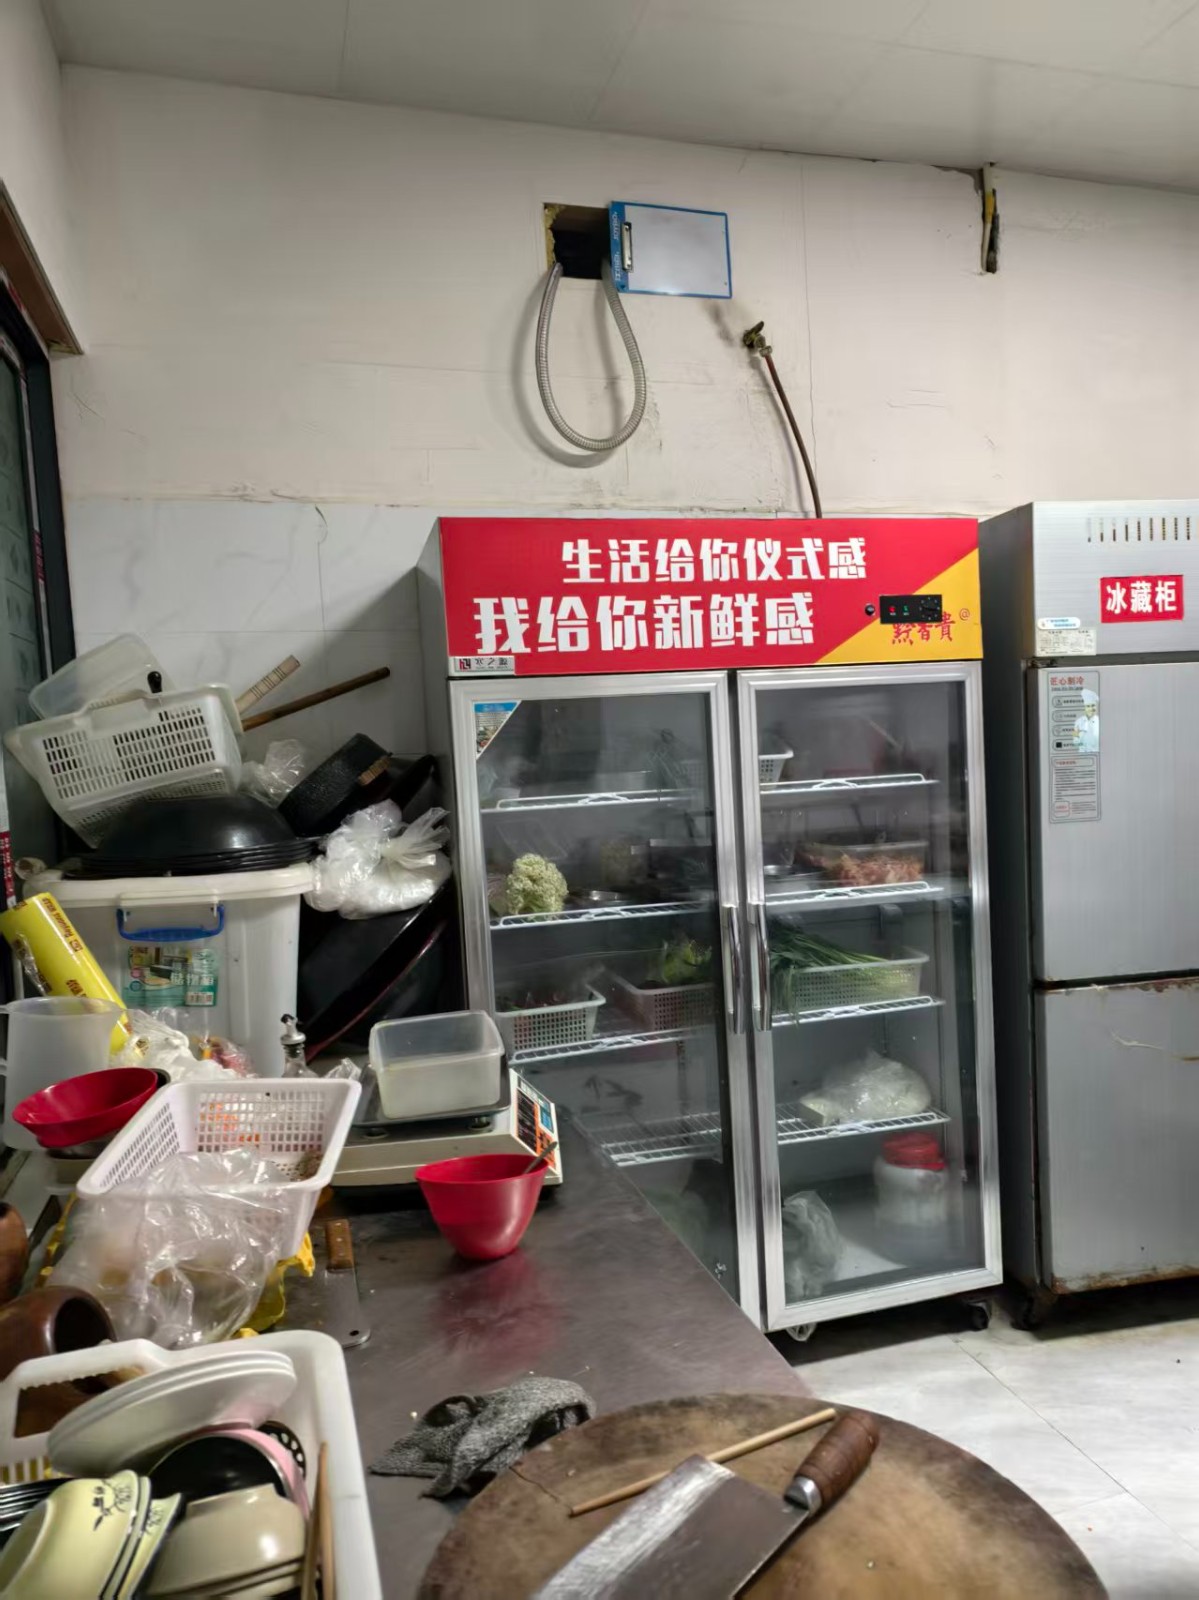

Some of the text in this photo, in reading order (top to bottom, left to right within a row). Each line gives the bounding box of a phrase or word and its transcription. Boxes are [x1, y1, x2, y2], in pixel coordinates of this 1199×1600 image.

[562, 538, 867, 583] 生活给你仪式感
[1106, 582, 1177, 614] 冰藏柜
[474, 592, 814, 653] 我给你新鲜感
